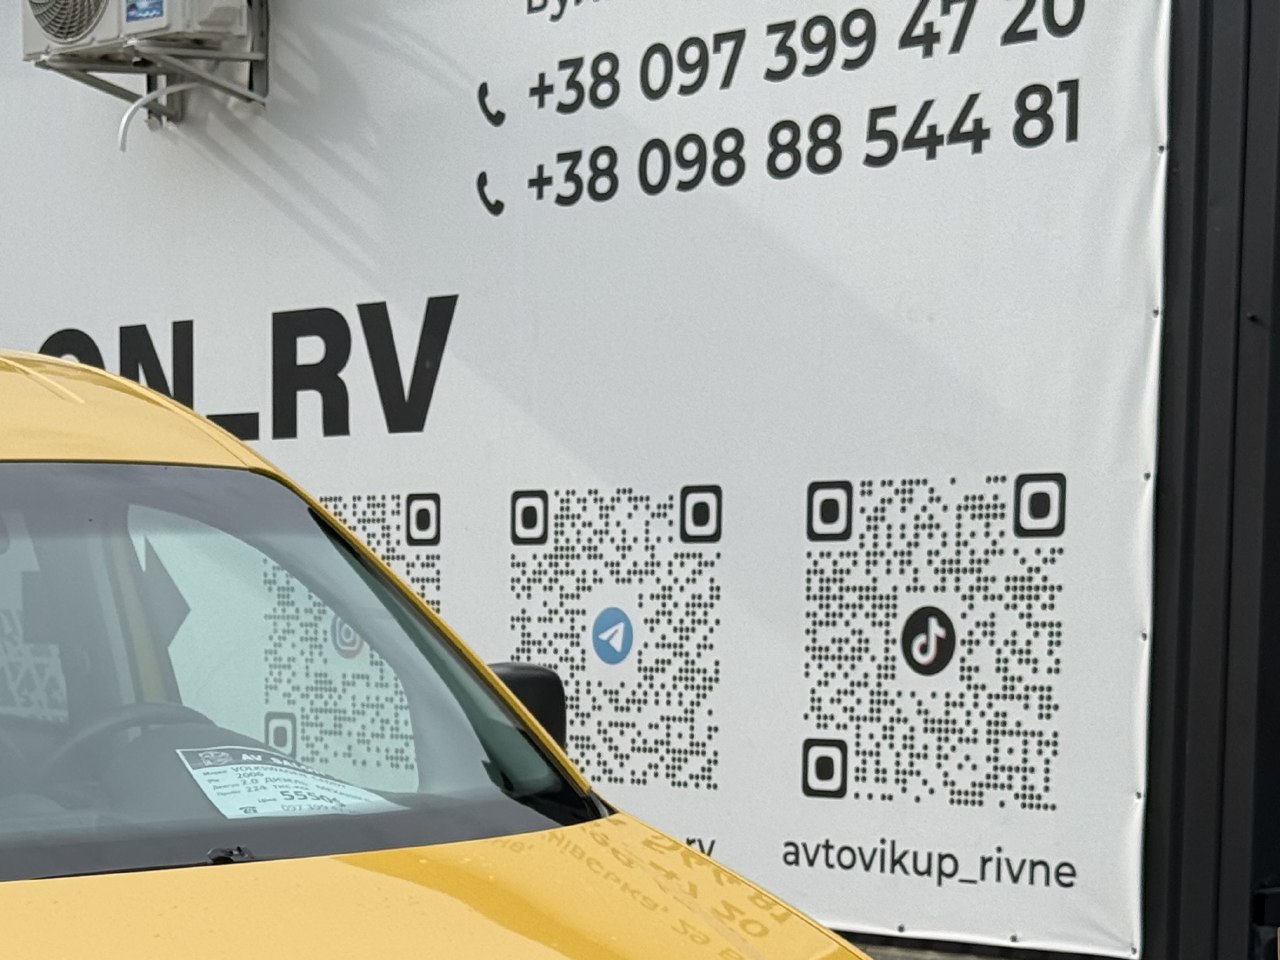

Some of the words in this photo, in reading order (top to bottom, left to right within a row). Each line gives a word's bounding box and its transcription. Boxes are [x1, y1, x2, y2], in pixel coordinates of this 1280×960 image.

[528, 51, 620, 115] +38
[640, 28, 746, 101] 097
[764, 8, 877, 82] 399
[898, 0, 979, 58] 47
[1000, 0, 1086, 46] 20
[526, 145, 619, 207] +38
[638, 127, 746, 196] 098
[766, 114, 843, 180] 88
[863, 92, 991, 168] 544
[1012, 78, 1080, 148] 81
[783, 839, 1078, 888] avtovikup_rivne
